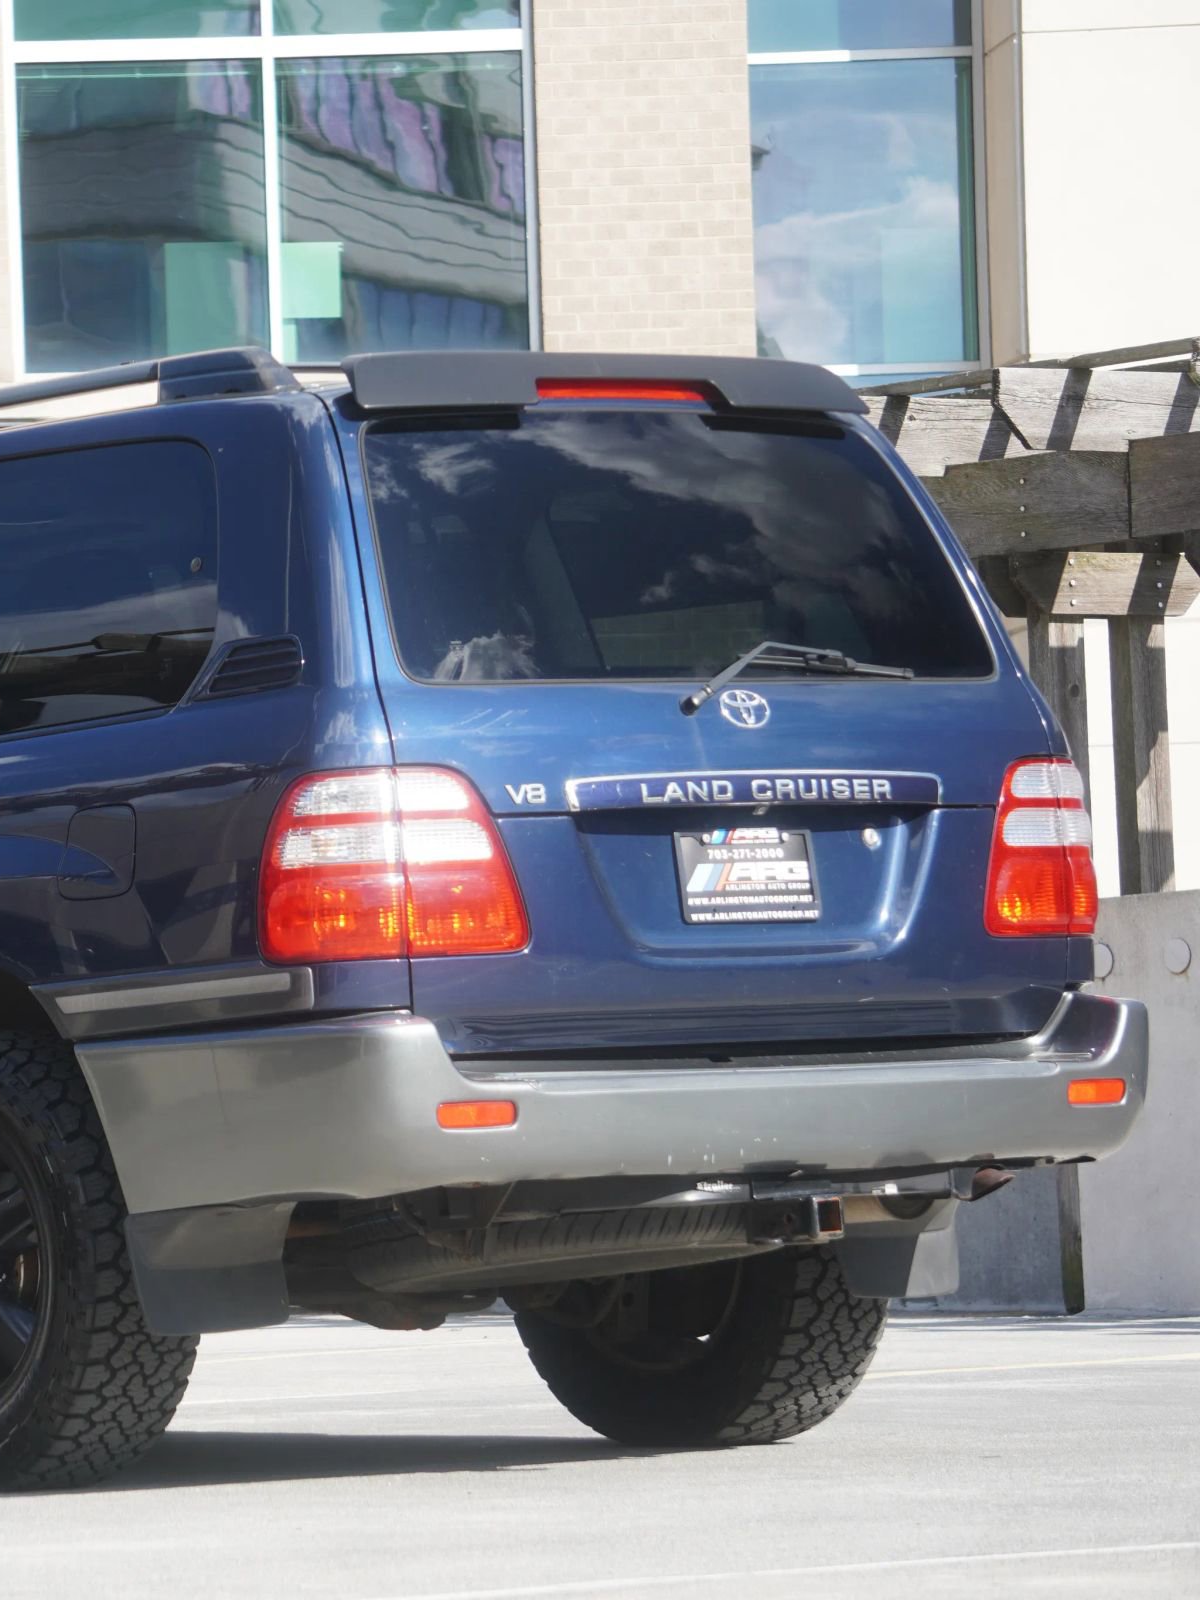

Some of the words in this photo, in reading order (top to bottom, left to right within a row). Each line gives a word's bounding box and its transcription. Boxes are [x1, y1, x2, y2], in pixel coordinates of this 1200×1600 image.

[505, 783, 547, 805] V8
[640, 781, 734, 804] LAND
[751, 778, 893, 802] CRUISER
[707, 847, 785, 860] 703-271-2000
[725, 883, 766, 891] ARLINGTON
[767, 882, 786, 890] AUTO
[787, 882, 811, 890] GROUP
[687, 894, 813, 906] WWW.ARLINGTONAUTOGROUP.NET
[690, 910, 819, 921] WWW.ARLINGTONAUTOGROUP.NET
